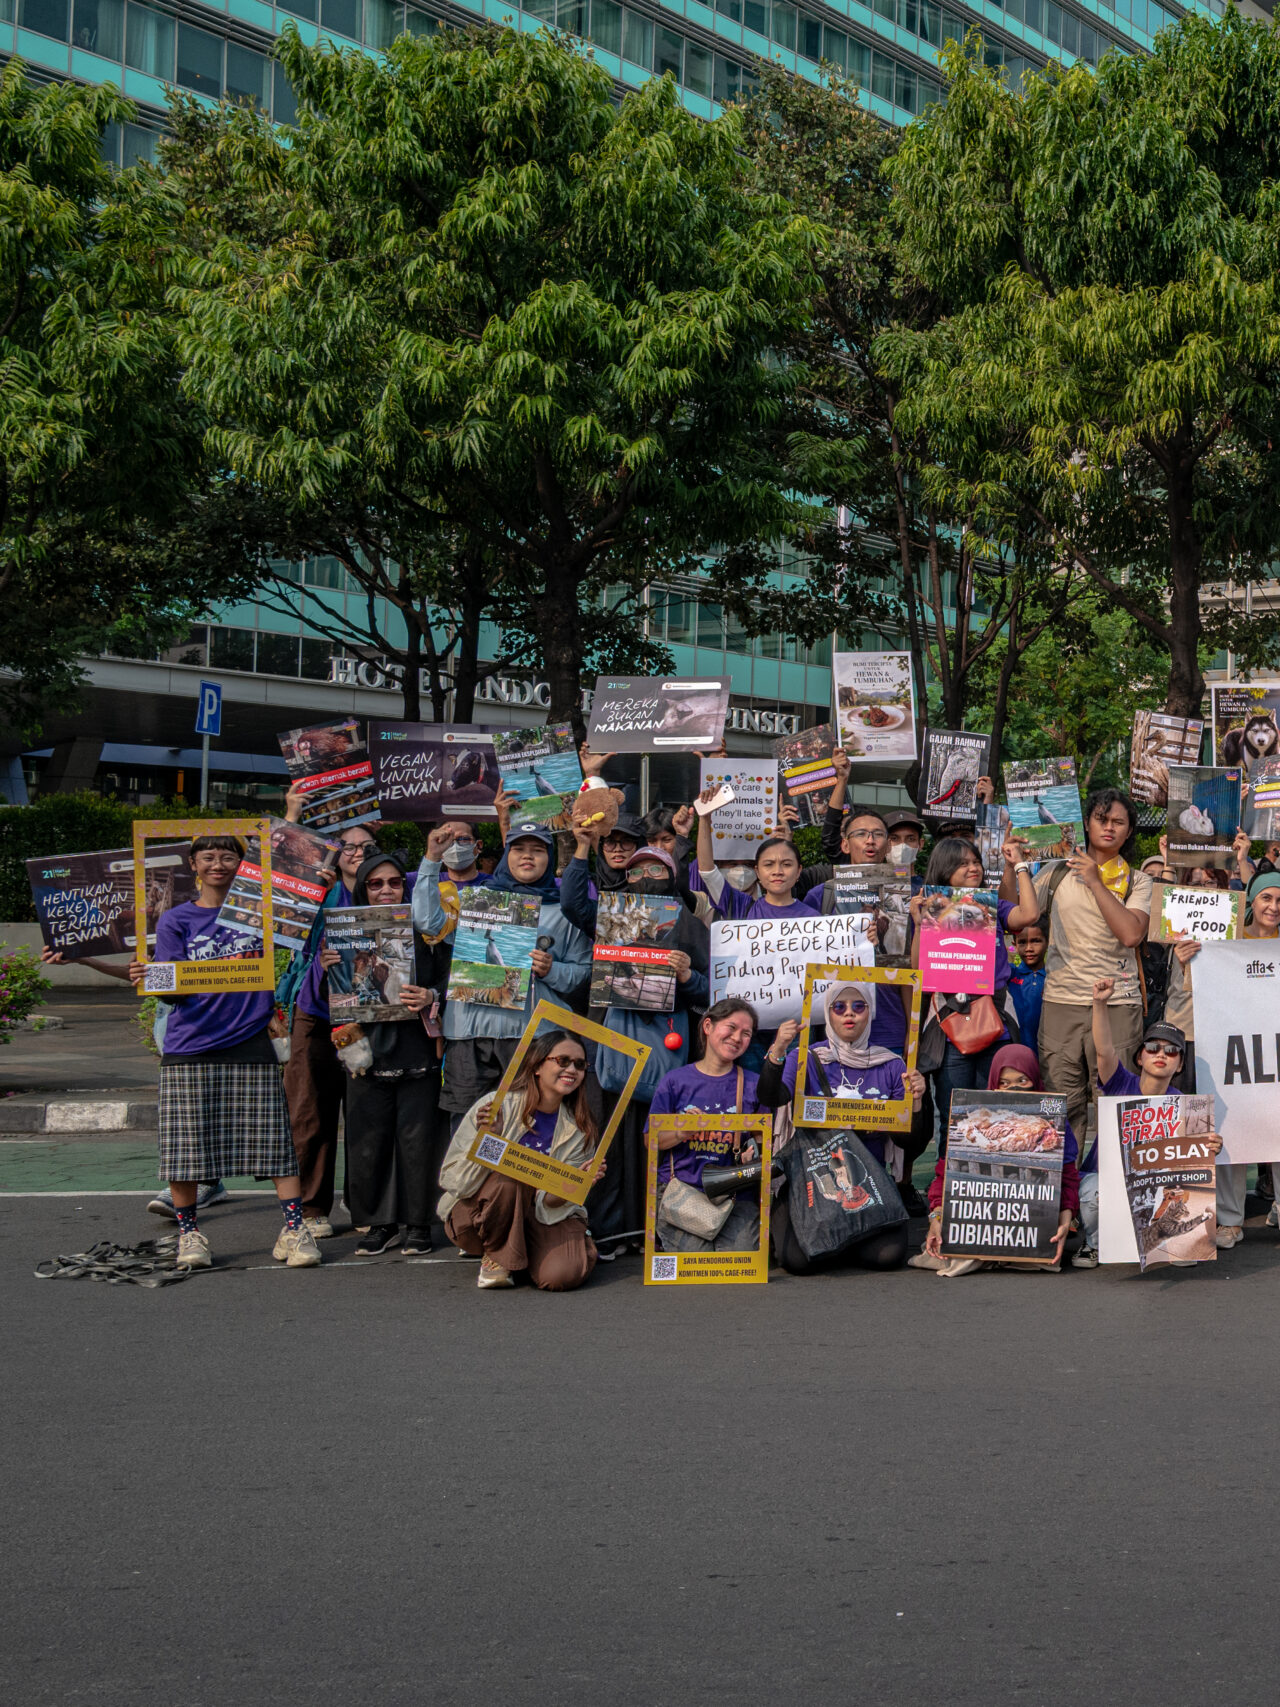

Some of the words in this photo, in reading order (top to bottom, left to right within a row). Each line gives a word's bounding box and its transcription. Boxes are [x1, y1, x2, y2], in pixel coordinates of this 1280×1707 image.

[202, 688, 218, 728] P
[602, 698, 658, 711] MEREKA
[607, 711, 653, 722] BUKAN
[594, 720, 664, 732] MAKANAN
[380, 732, 391, 740] 21
[930, 734, 952, 744] GAJAH
[955, 738, 986, 748] RAHMAN
[379, 752, 434, 770] VEGAN
[380, 766, 436, 784] UNTUK
[378, 778, 442, 800] HEWAN
[735, 822, 743, 830] of
[1170, 842, 1187, 850] Hewan
[42, 870, 53, 879] 21
[43, 882, 114, 906] HENTIKAN
[858, 894, 880, 903] Pekerja.
[1170, 894, 1219, 906] FRIENDS!
[47, 891, 128, 918] KEKEJAMAN
[50, 906, 122, 934] TERHADAP
[326, 916, 356, 924] Hentikan
[1192, 921, 1226, 932] FOOD
[54, 924, 110, 947] HEWAN
[327, 928, 363, 938] Eksploitasi
[721, 921, 773, 944] STOP
[781, 916, 872, 936] BACKYARD
[328, 942, 350, 950] Hewan
[351, 940, 378, 950] Pekerja.
[751, 935, 856, 957] BREEDER!!!
[596, 948, 620, 956] Hewan
[621, 950, 649, 958] diternak
[953, 952, 986, 960] PERAMPASAN
[182, 966, 196, 974] SAYA
[230, 964, 260, 972] PLATARAN
[715, 960, 776, 986] Ending
[1246, 960, 1266, 974] affa
[230, 976, 264, 984] CAGE-FREE!
[779, 984, 790, 996] in
[1122, 1106, 1174, 1128] FROM
[1122, 1120, 1181, 1144] STRAY
[1136, 1148, 1159, 1164] TO
[1164, 1144, 1210, 1160] SLAY
[502, 1159, 517, 1170] 100%
[516, 1164, 544, 1181] CAGE-FREE!
[508, 1148, 520, 1158] SAYA
[520, 1152, 548, 1170] MENDORONG
[548, 1164, 561, 1174] TOUS
[560, 1168, 570, 1178] LES
[569, 1172, 584, 1184] JOURS
[1133, 1178, 1154, 1186] ADOPT,
[951, 1180, 1034, 1201] PENDERITAAN
[1038, 1184, 1054, 1202] INI
[950, 1200, 993, 1221] TIDAK
[996, 1202, 1030, 1222] BISA
[948, 1223, 1038, 1248] DIBIARKAN
[734, 1256, 752, 1264] UNION
